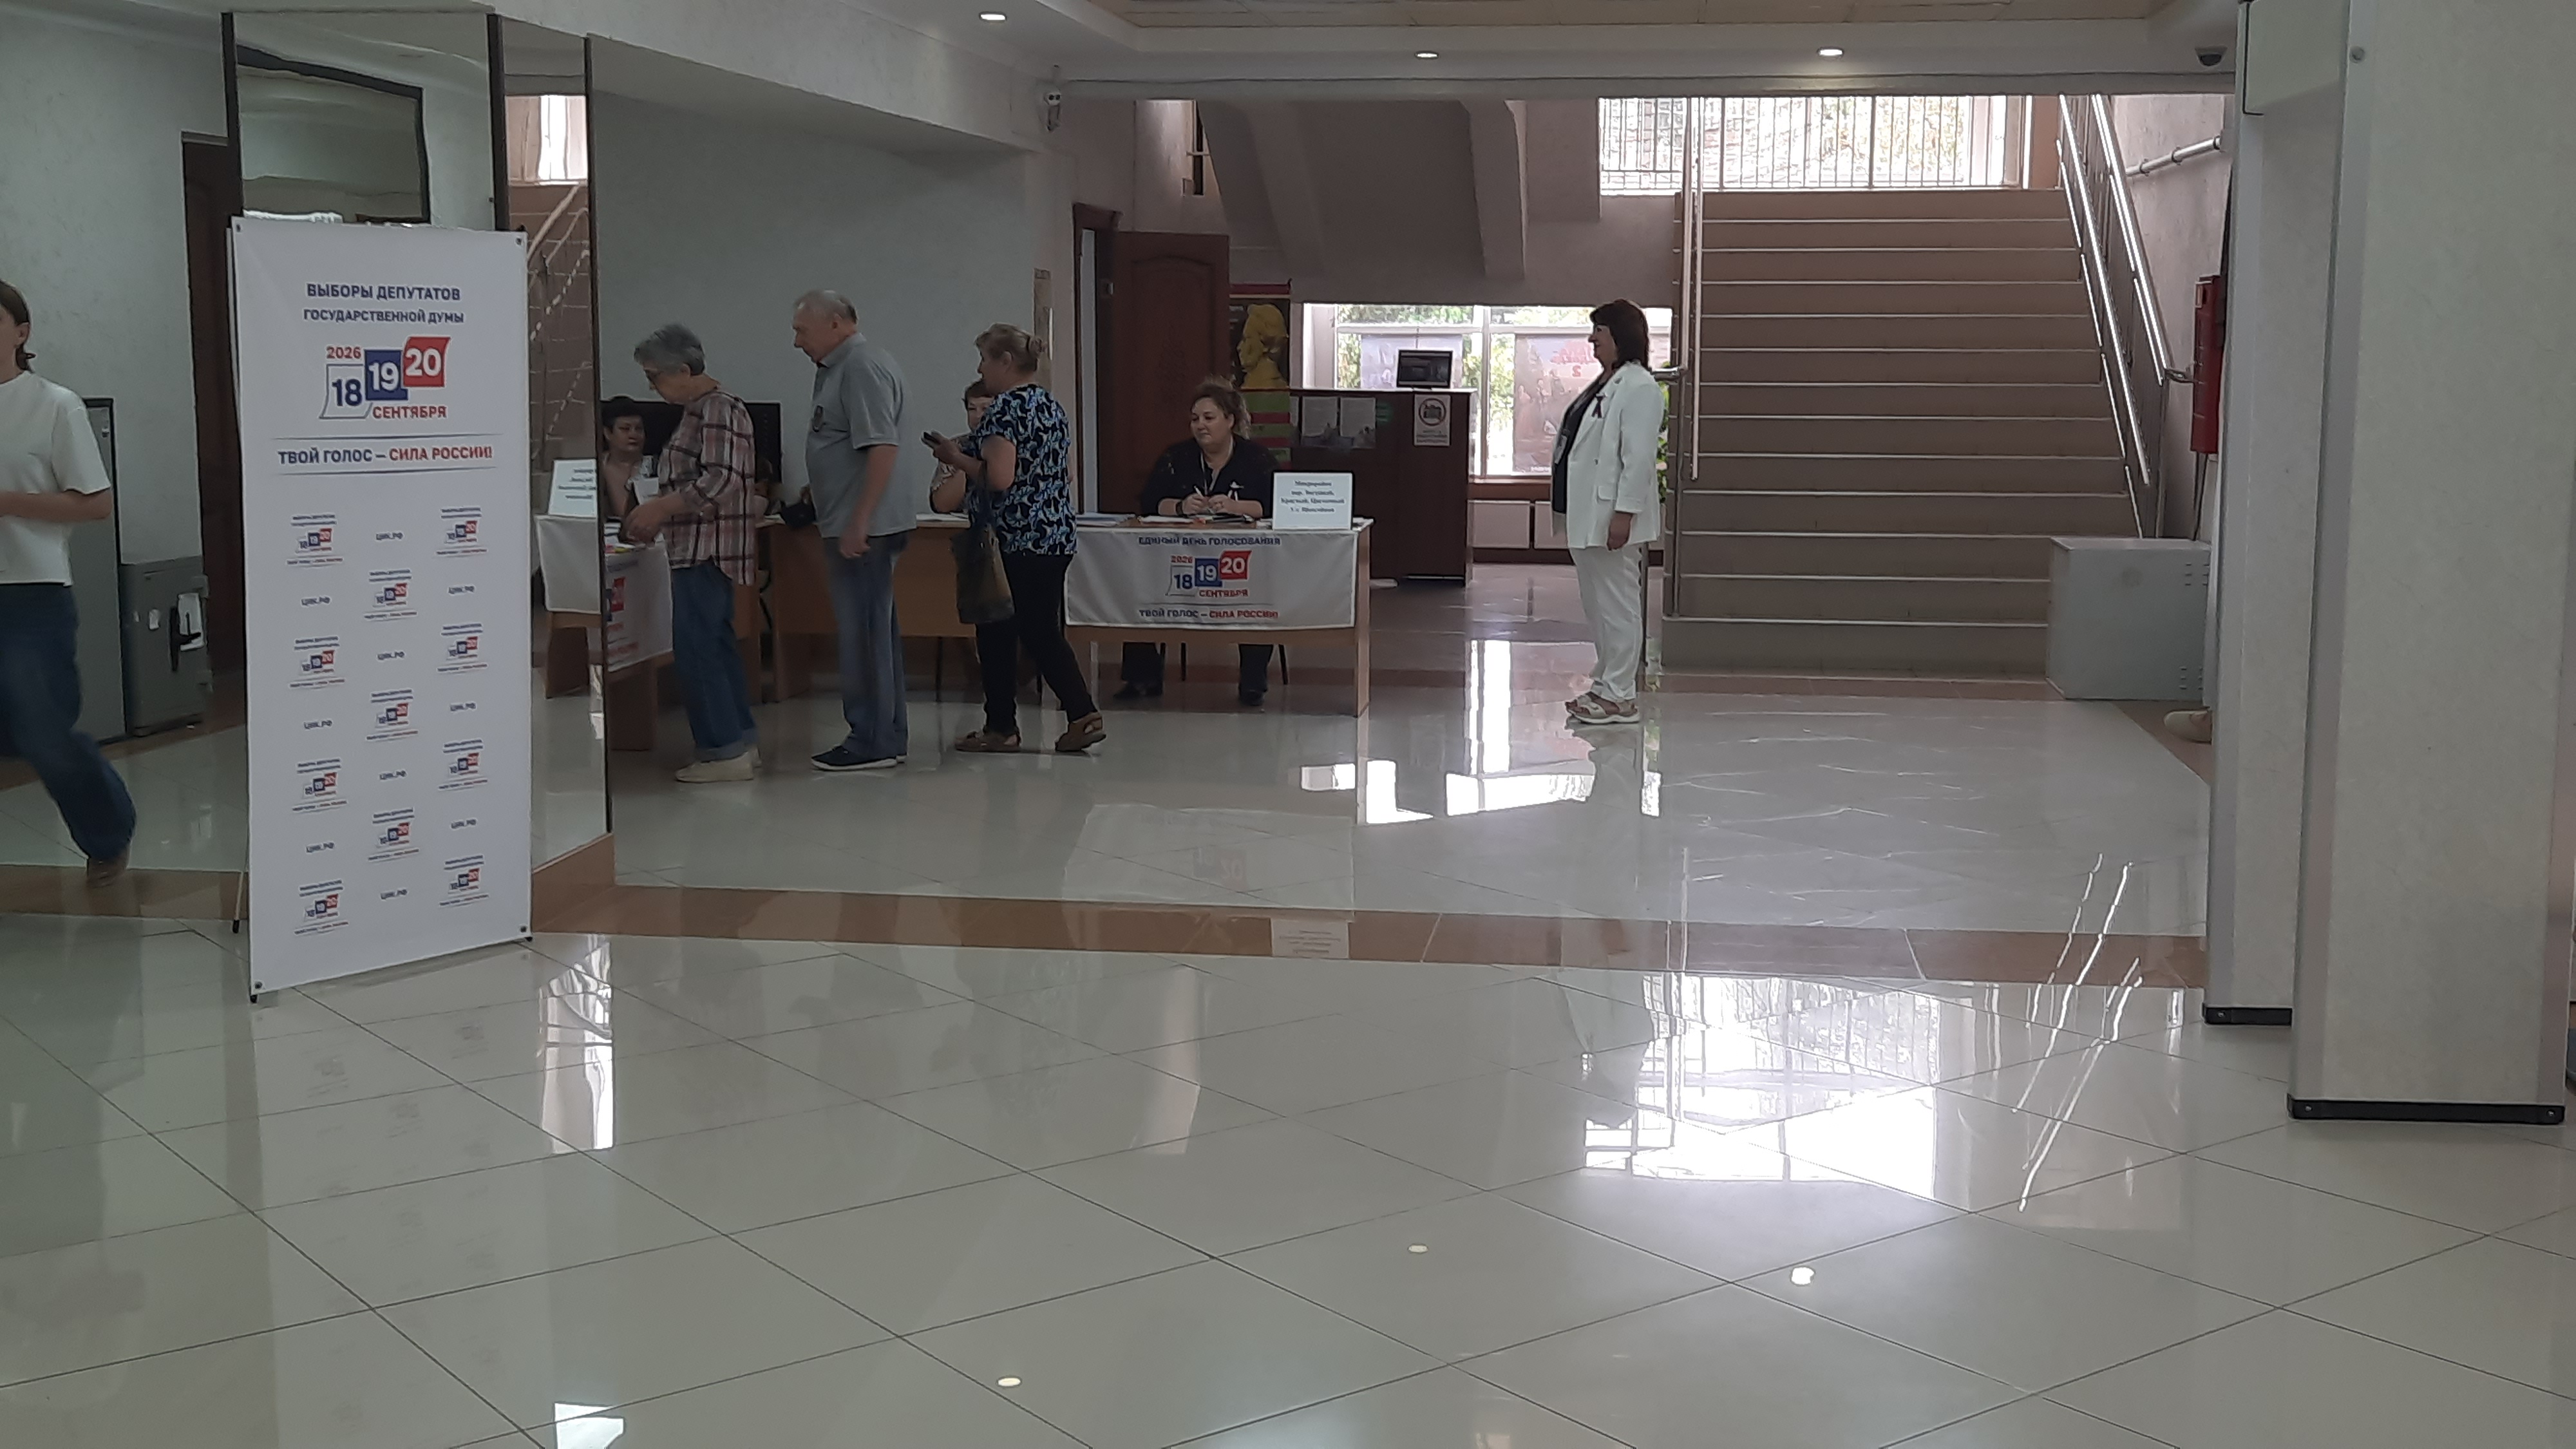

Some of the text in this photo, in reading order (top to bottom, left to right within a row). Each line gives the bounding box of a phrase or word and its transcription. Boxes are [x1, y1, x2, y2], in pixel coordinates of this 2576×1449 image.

[307, 283, 460, 301] ВЫБОРЫ ДЕПУТАТОВ
[303, 309, 464, 324] ГОСУДАРСТВЕННОЙ ДУМЫ
[327, 346, 361, 359] 2026
[332, 348, 442, 406] 18 19 20
[372, 406, 447, 419] СЕНТЯБРЯ
[278, 447, 319, 464] ТВОЙ
[323, 449, 372, 463] ГОЛОС
[389, 448, 427, 461] СИЛА
[432, 446, 492, 460] РОССИИ!
[1209, 537, 1280, 545] ГОЛОСОВАНИЯ
[1174, 558, 1245, 589] 18 19 20
[1199, 589, 1248, 598] СЕНТЯБРЯ
[1139, 609, 1164, 617] ТВОЙ
